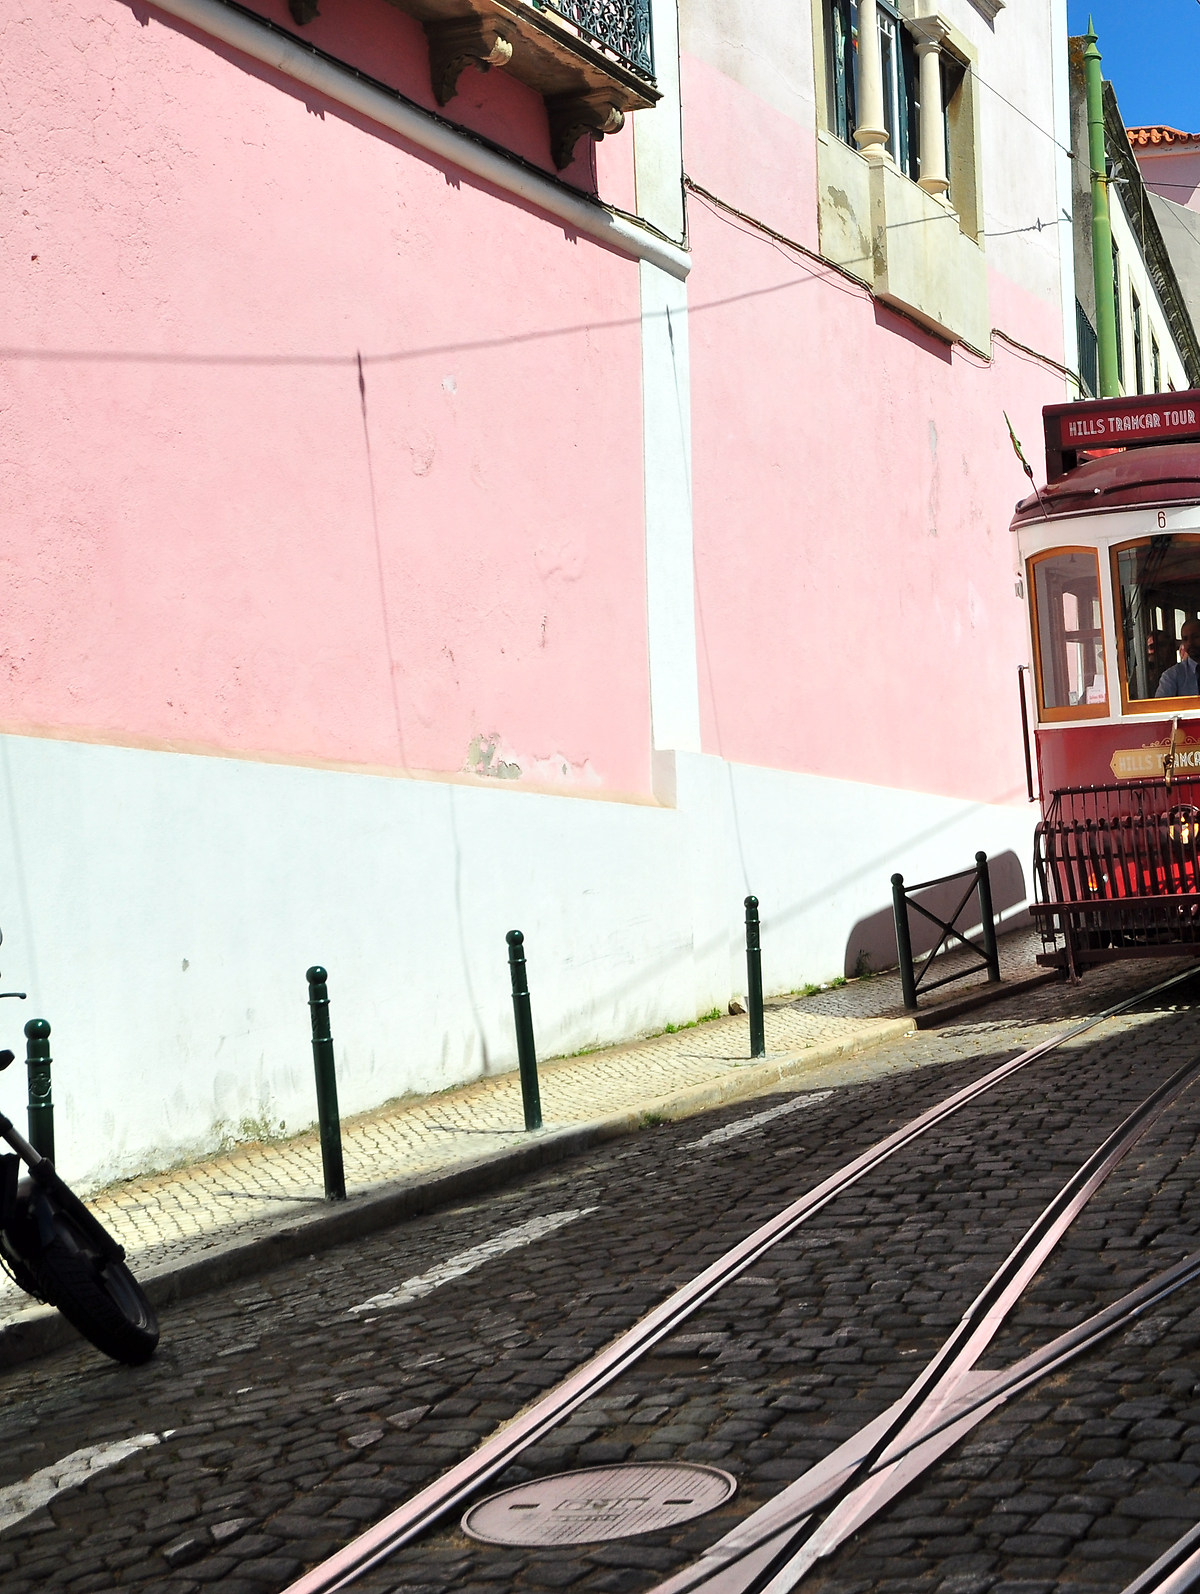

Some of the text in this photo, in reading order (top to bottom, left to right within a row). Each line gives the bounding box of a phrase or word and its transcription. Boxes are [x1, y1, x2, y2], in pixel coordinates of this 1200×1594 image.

[1069, 409, 1196, 436] HILLS TRAMCAR TOUR
[1157, 511, 1166, 528] 6
[1119, 754, 1153, 772] HILLS
